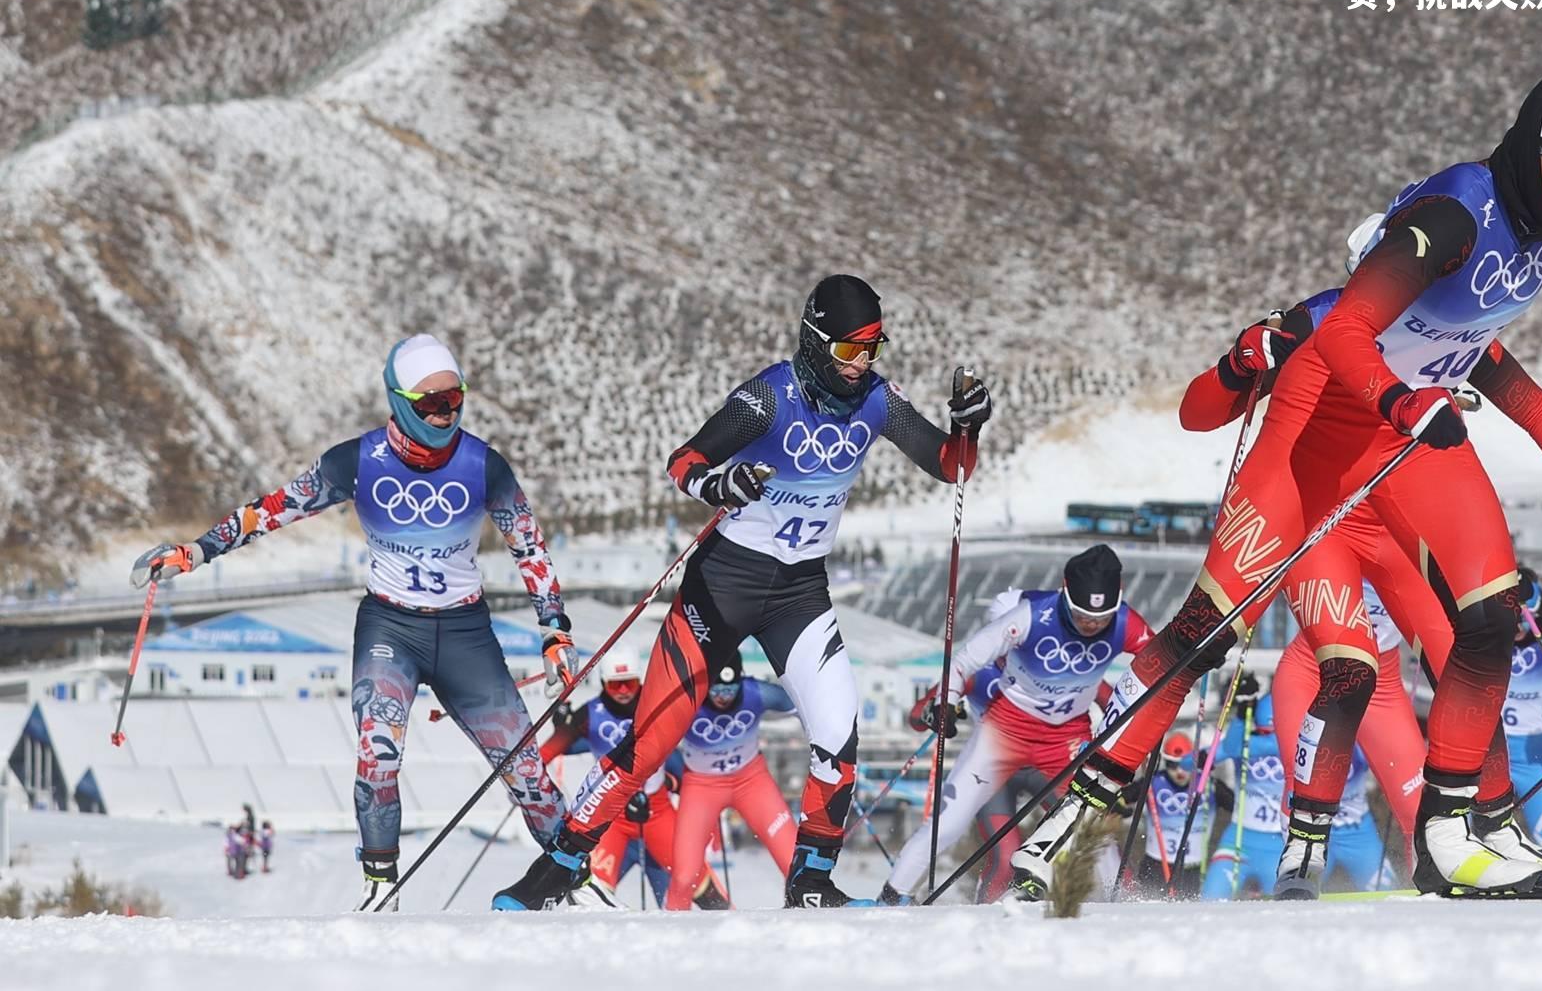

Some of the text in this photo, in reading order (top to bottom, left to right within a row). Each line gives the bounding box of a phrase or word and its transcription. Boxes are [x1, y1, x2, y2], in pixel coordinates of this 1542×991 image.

[1404, 315, 1489, 343] BEIJING
[1419, 347, 1481, 383] 40
[762, 486, 849, 509] EIJING 20
[774, 516, 828, 548] 42
[1215, 482, 1288, 604] HINA
[431, 538, 472, 559] 2022
[404, 565, 448, 595] 13
[1284, 577, 1376, 640] HINA
[1036, 698, 1076, 716] 24
[1503, 707, 1518, 726] 6
[575, 770, 620, 825] CANADA
